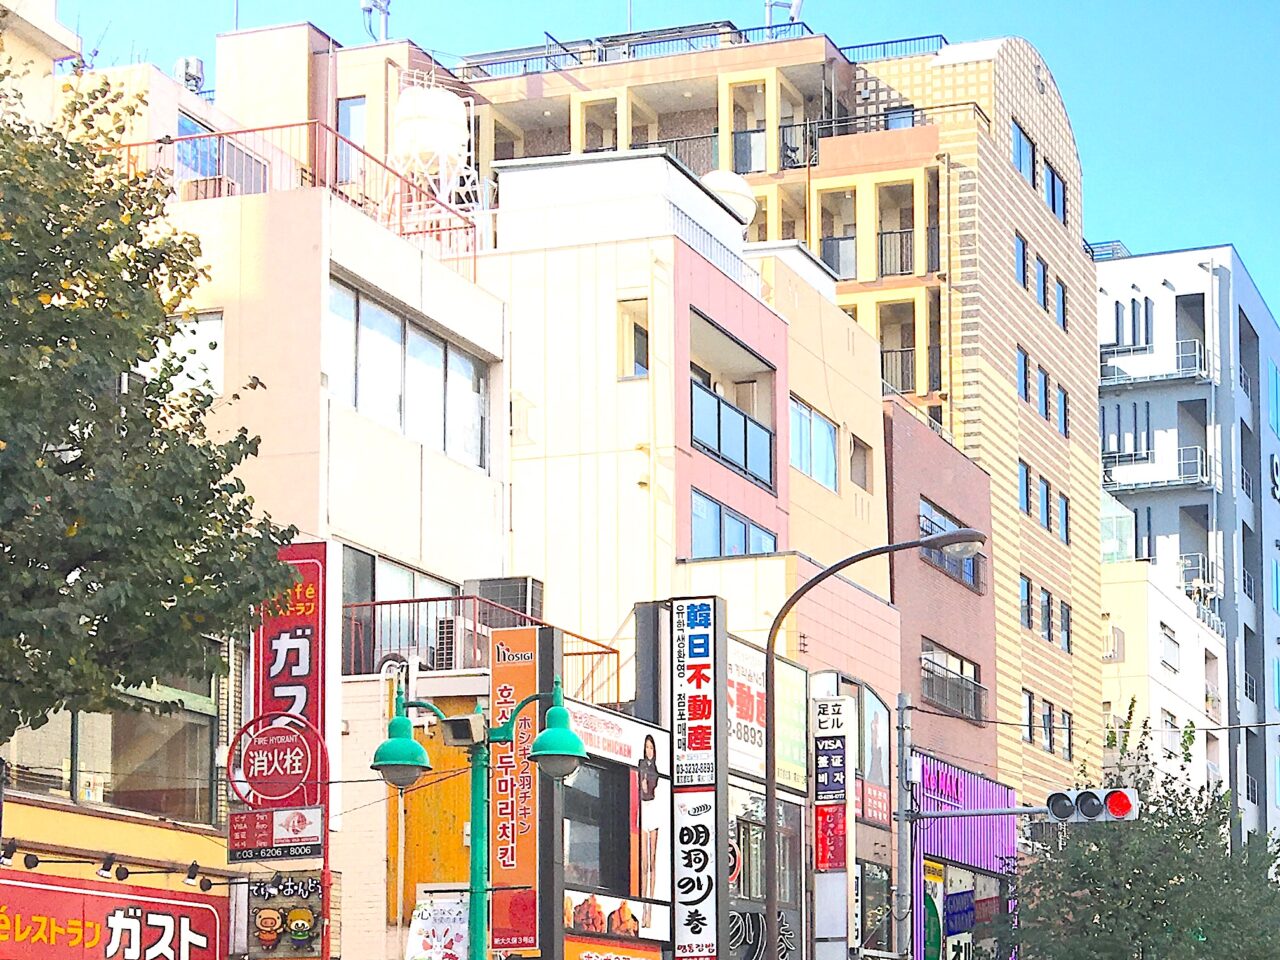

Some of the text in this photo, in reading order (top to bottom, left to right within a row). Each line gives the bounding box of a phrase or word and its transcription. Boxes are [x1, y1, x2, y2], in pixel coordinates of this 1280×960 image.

[818, 703, 843, 716] 足立
[818, 717, 843, 730] ビル
[254, 734, 299, 746] FIRE HYDRANT
[817, 740, 844, 751] VISA
[248, 746, 305, 778] 消火栓
